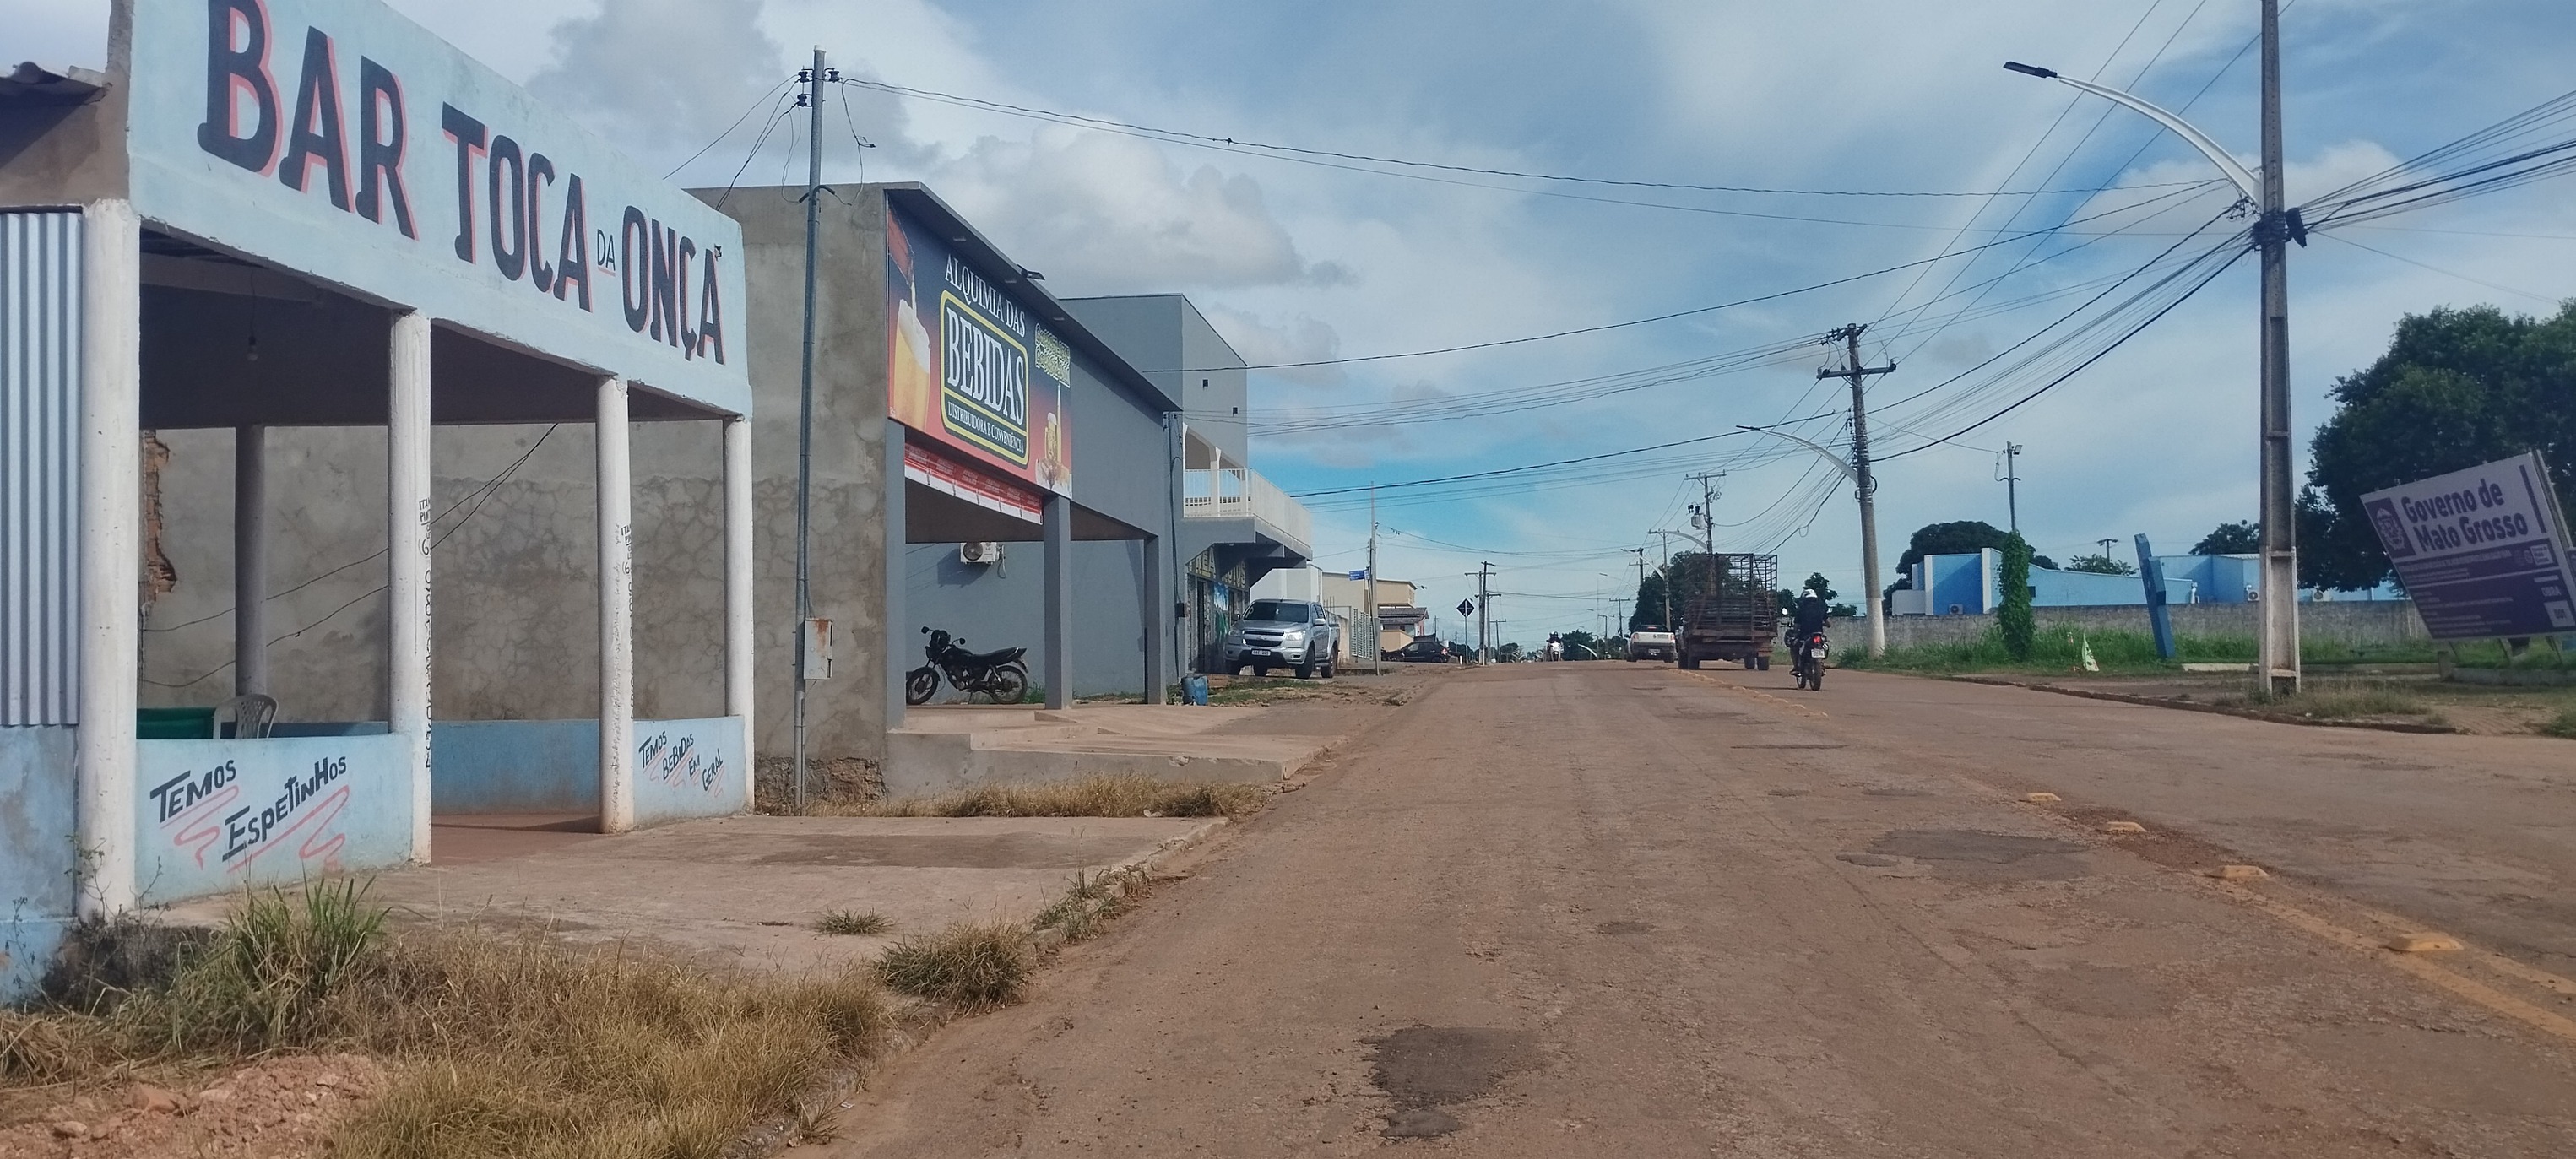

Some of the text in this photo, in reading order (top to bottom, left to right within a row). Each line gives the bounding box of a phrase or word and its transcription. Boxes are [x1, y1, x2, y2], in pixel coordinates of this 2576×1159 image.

[197, 0, 725, 366] BAR TOCA DA ONÇA
[945, 253, 1025, 338] ALQUIMIA DAS
[946, 306, 1024, 425] BEBIDAS
[947, 401, 1025, 454] DISTRIBUIDORA E CONVENIÊNCIA
[2400, 478, 2505, 524] Governo de
[2413, 512, 2529, 552] Mato Grosso
[639, 731, 667, 769] TEMOS
[663, 733, 694, 781] BEBIDAS
[689, 754, 700, 777] EM
[702, 748, 724, 792] GERAL
[149, 760, 236, 823] TEMOS
